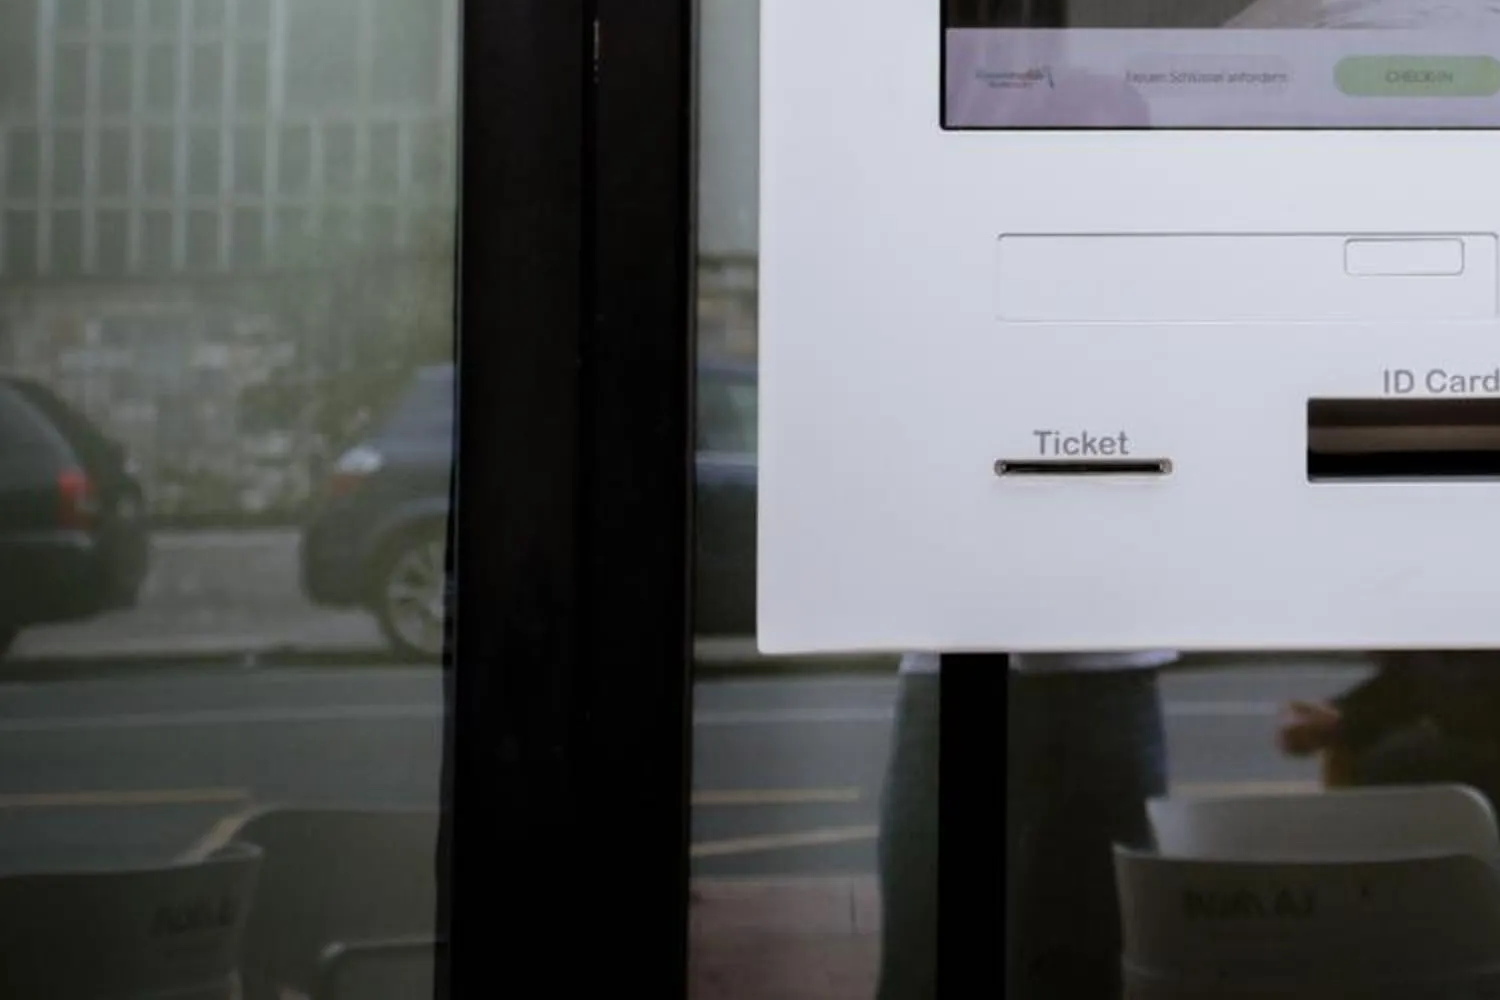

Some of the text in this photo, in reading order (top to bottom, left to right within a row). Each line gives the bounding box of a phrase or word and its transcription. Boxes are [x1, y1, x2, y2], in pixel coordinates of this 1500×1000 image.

[1382, 368, 1500, 394] ID Card
[1033, 430, 1131, 456] Ticket
